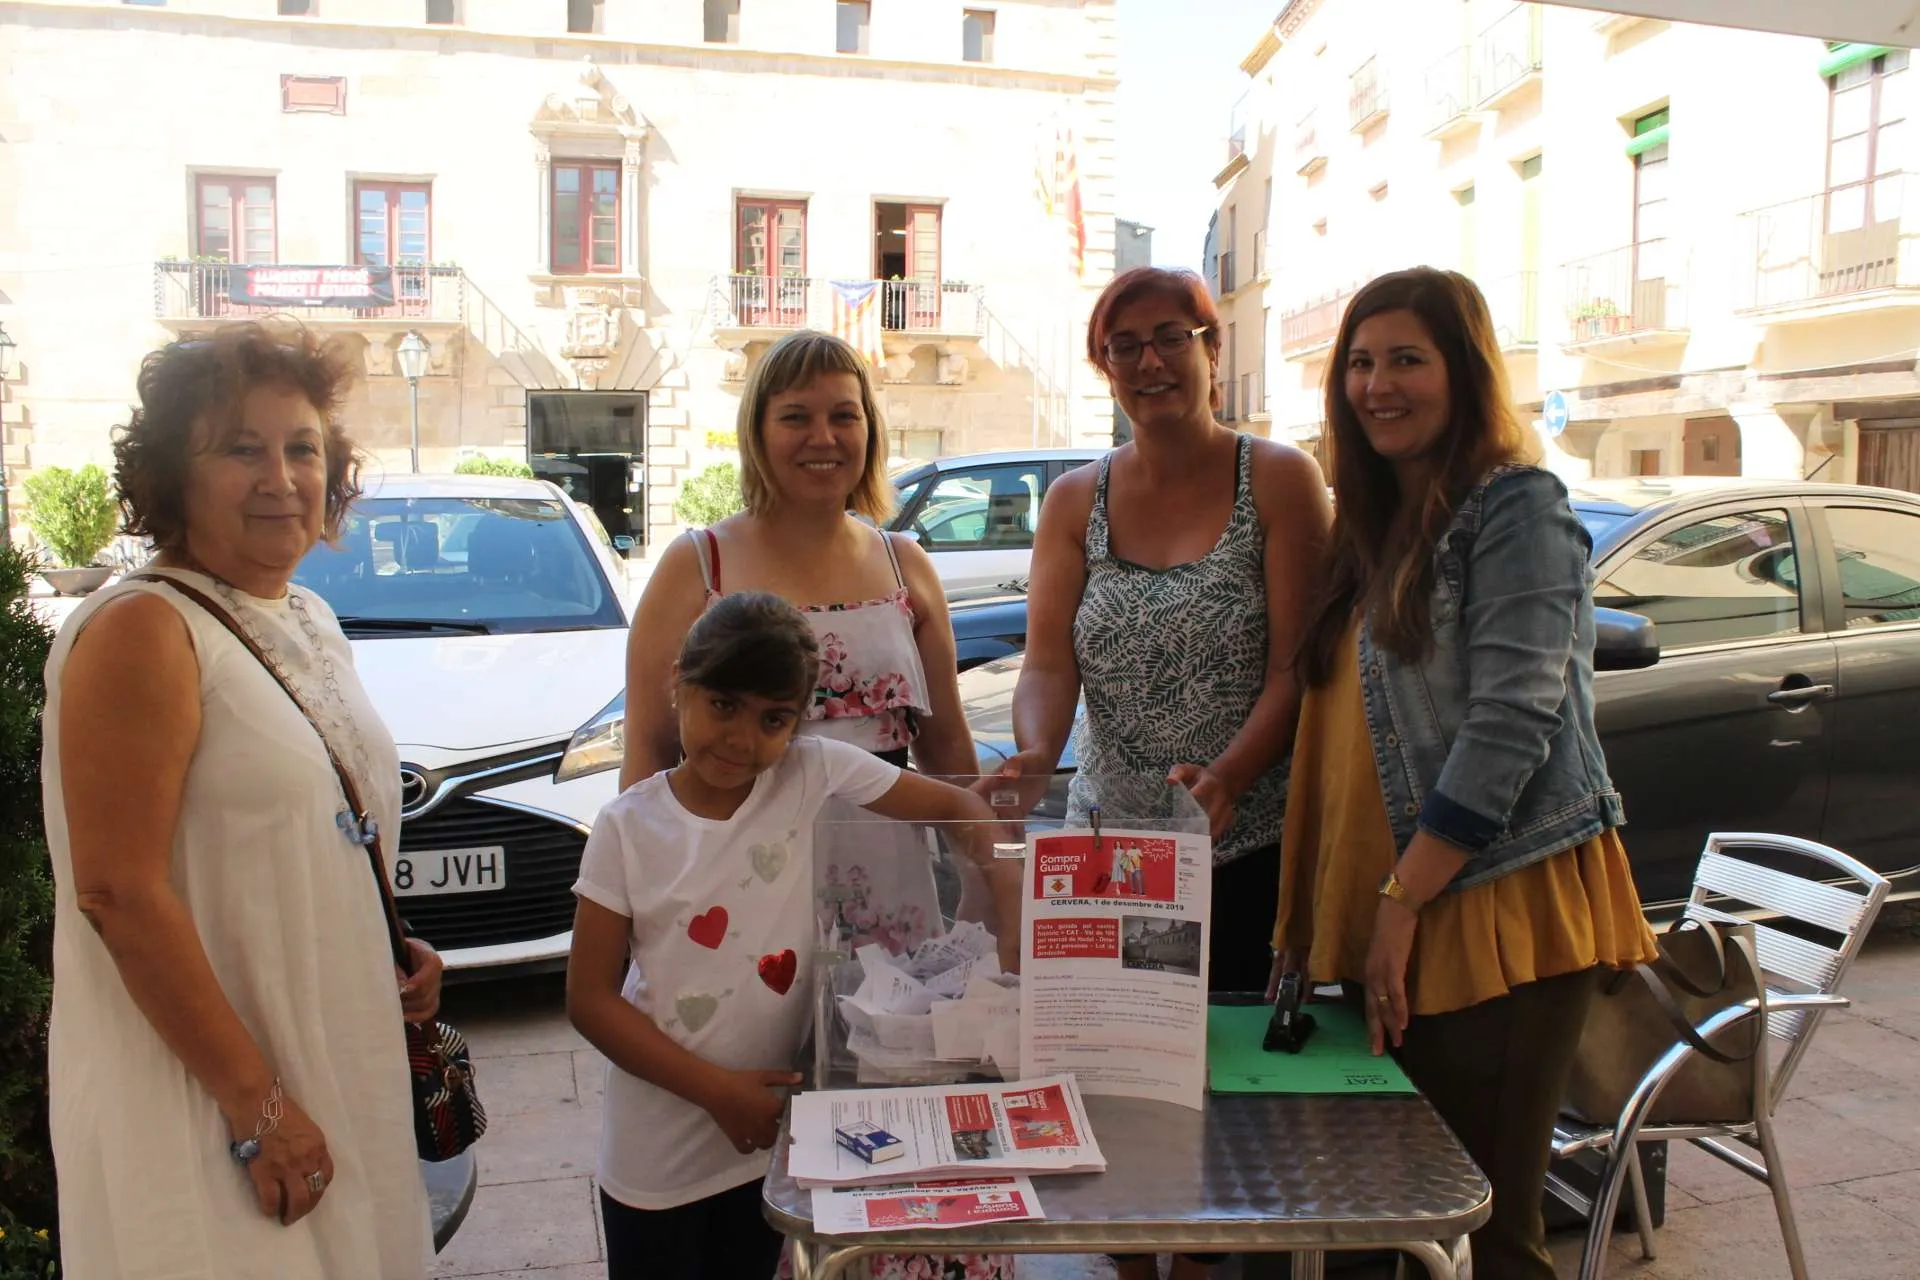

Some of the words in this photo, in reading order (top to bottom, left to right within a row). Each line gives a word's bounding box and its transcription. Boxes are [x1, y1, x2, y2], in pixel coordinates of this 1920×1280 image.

[1040, 855, 1081, 865] Compra
[430, 853, 496, 888] JVH
[1039, 863, 1078, 873] Guanya
[1050, 899, 1092, 907] CERVERA,
[1113, 900, 1152, 908] desembre
[1165, 903, 1184, 911] 2019
